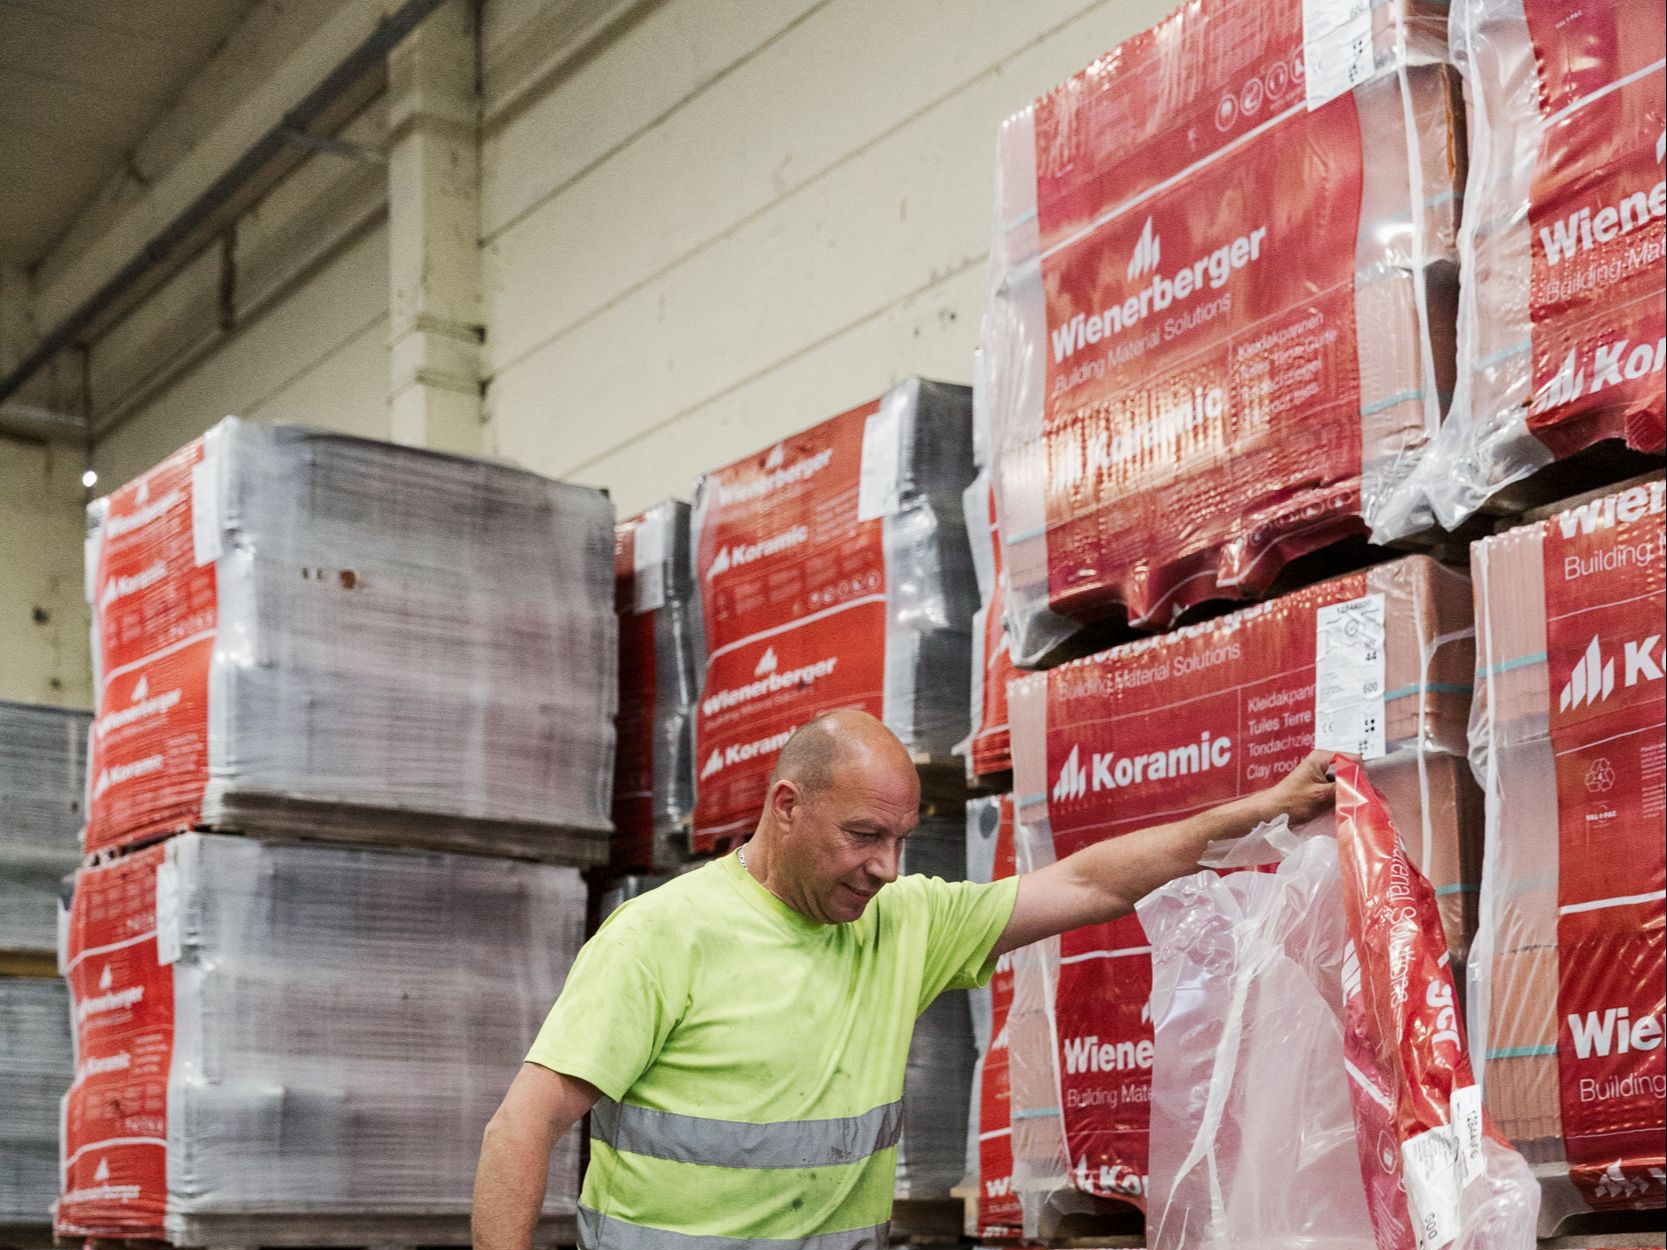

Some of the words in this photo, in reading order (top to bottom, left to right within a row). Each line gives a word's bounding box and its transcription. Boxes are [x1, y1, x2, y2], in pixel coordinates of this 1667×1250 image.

[1052, 225, 1267, 363] Wienerberger
[1544, 259, 1623, 304] Building
[1054, 358, 1105, 396] Building
[1106, 328, 1160, 368] Material
[1164, 293, 1232, 341] Solutions
[1564, 541, 1651, 581] Building
[1115, 661, 1169, 689] Material
[1173, 642, 1241, 677] Solutions
[1092, 730, 1232, 791] Koramic
[1567, 1006, 1666, 1060] Wie
[1579, 1072, 1666, 1103] Building
